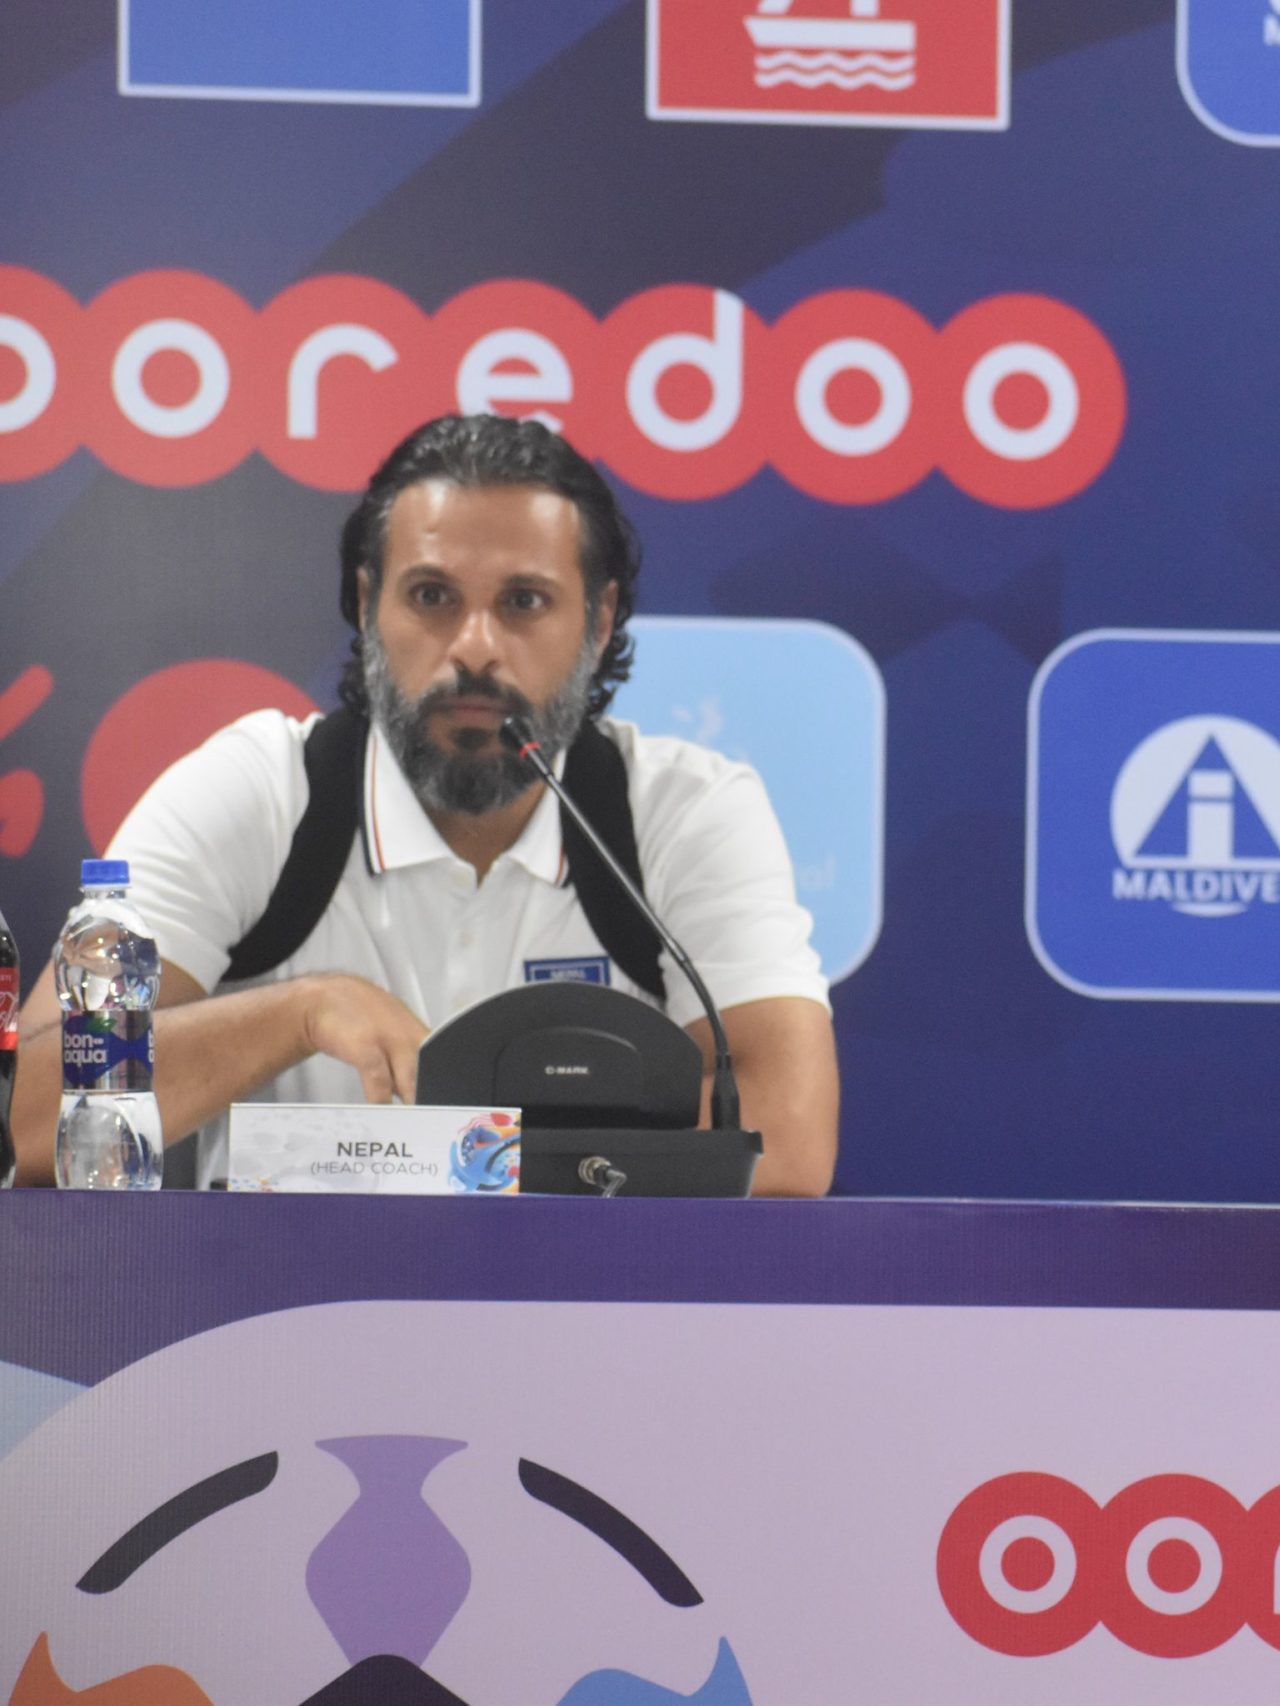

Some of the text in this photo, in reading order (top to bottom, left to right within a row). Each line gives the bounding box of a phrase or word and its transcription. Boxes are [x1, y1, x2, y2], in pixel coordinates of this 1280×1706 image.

[337, 1141, 414, 1158] NEPAL
[310, 1161, 439, 1177] (HEAD COACH)
